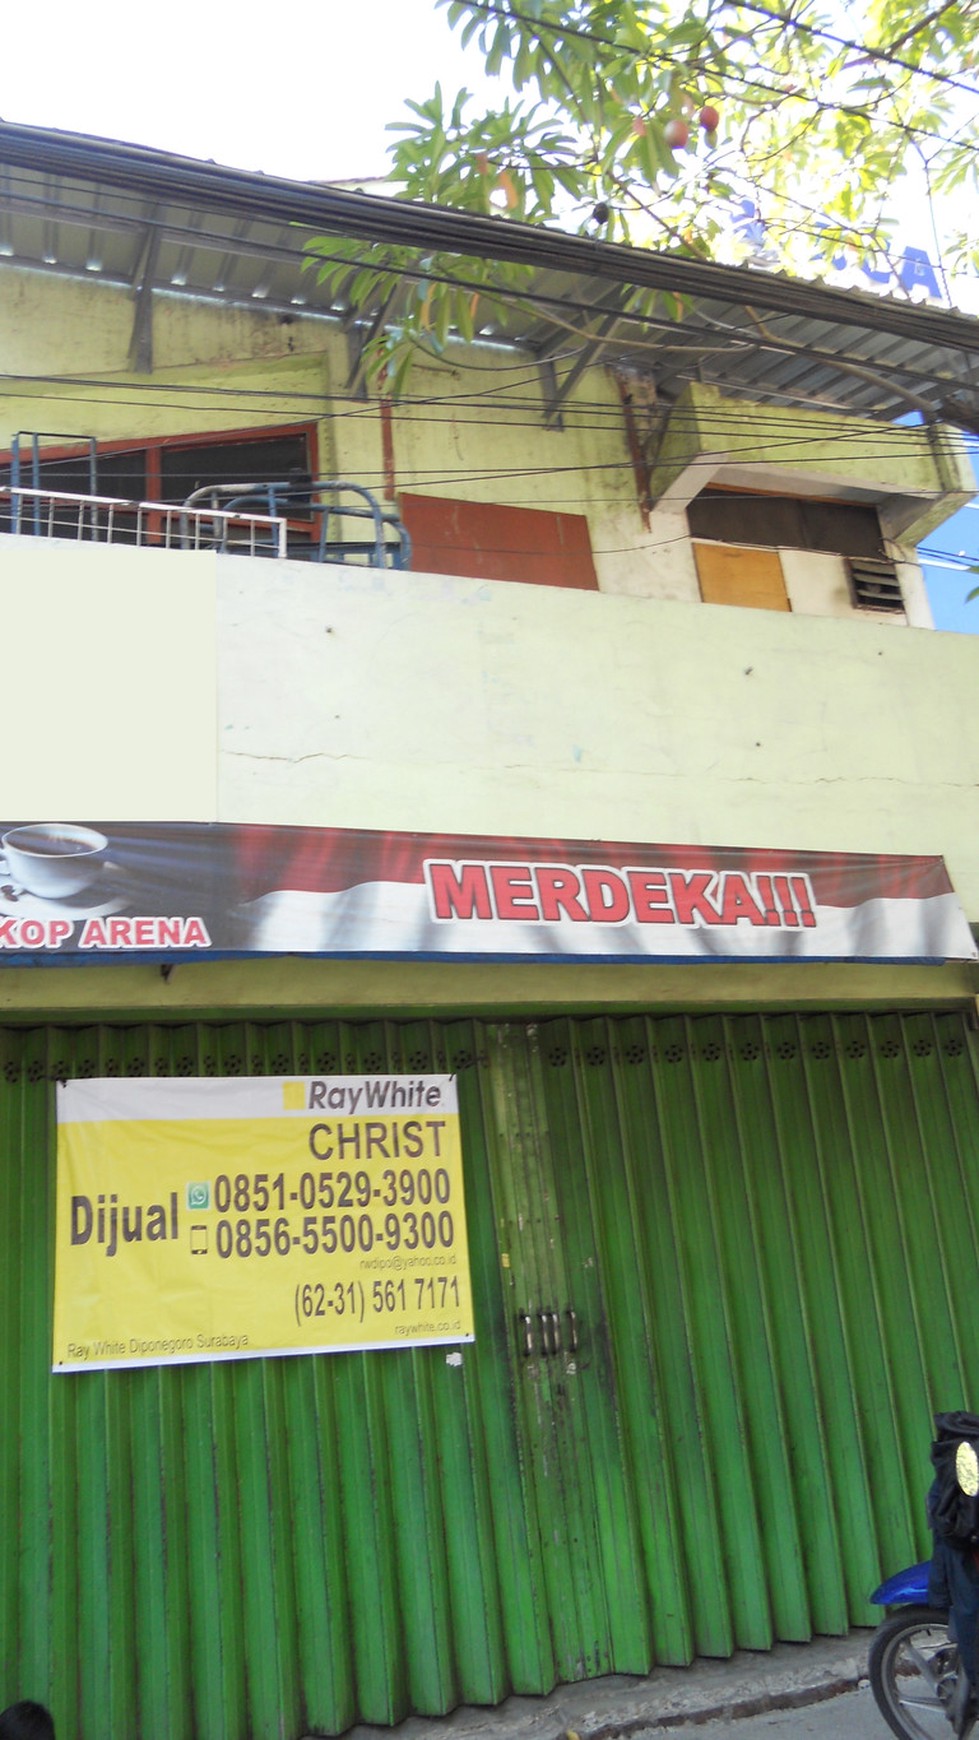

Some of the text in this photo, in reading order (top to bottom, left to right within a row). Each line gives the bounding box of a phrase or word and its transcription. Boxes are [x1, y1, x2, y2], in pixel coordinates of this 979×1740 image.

[424, 859, 817, 928] MERDEKA!!!
[79, 917, 211, 947] ARENA
[309, 1121, 446, 1161] CHRIST
[214, 1167, 451, 1213] 0851-0529-3900
[70, 1192, 179, 1256] Dijual
[216, 1210, 454, 1259] 0856-5500-9300
[294, 1275, 460, 1326] (62-31) 561 7171
[67, 1333, 250, 1361] Ray White Diponegoro Surabaya
[394, 1320, 461, 1336] raywhite.co.id
